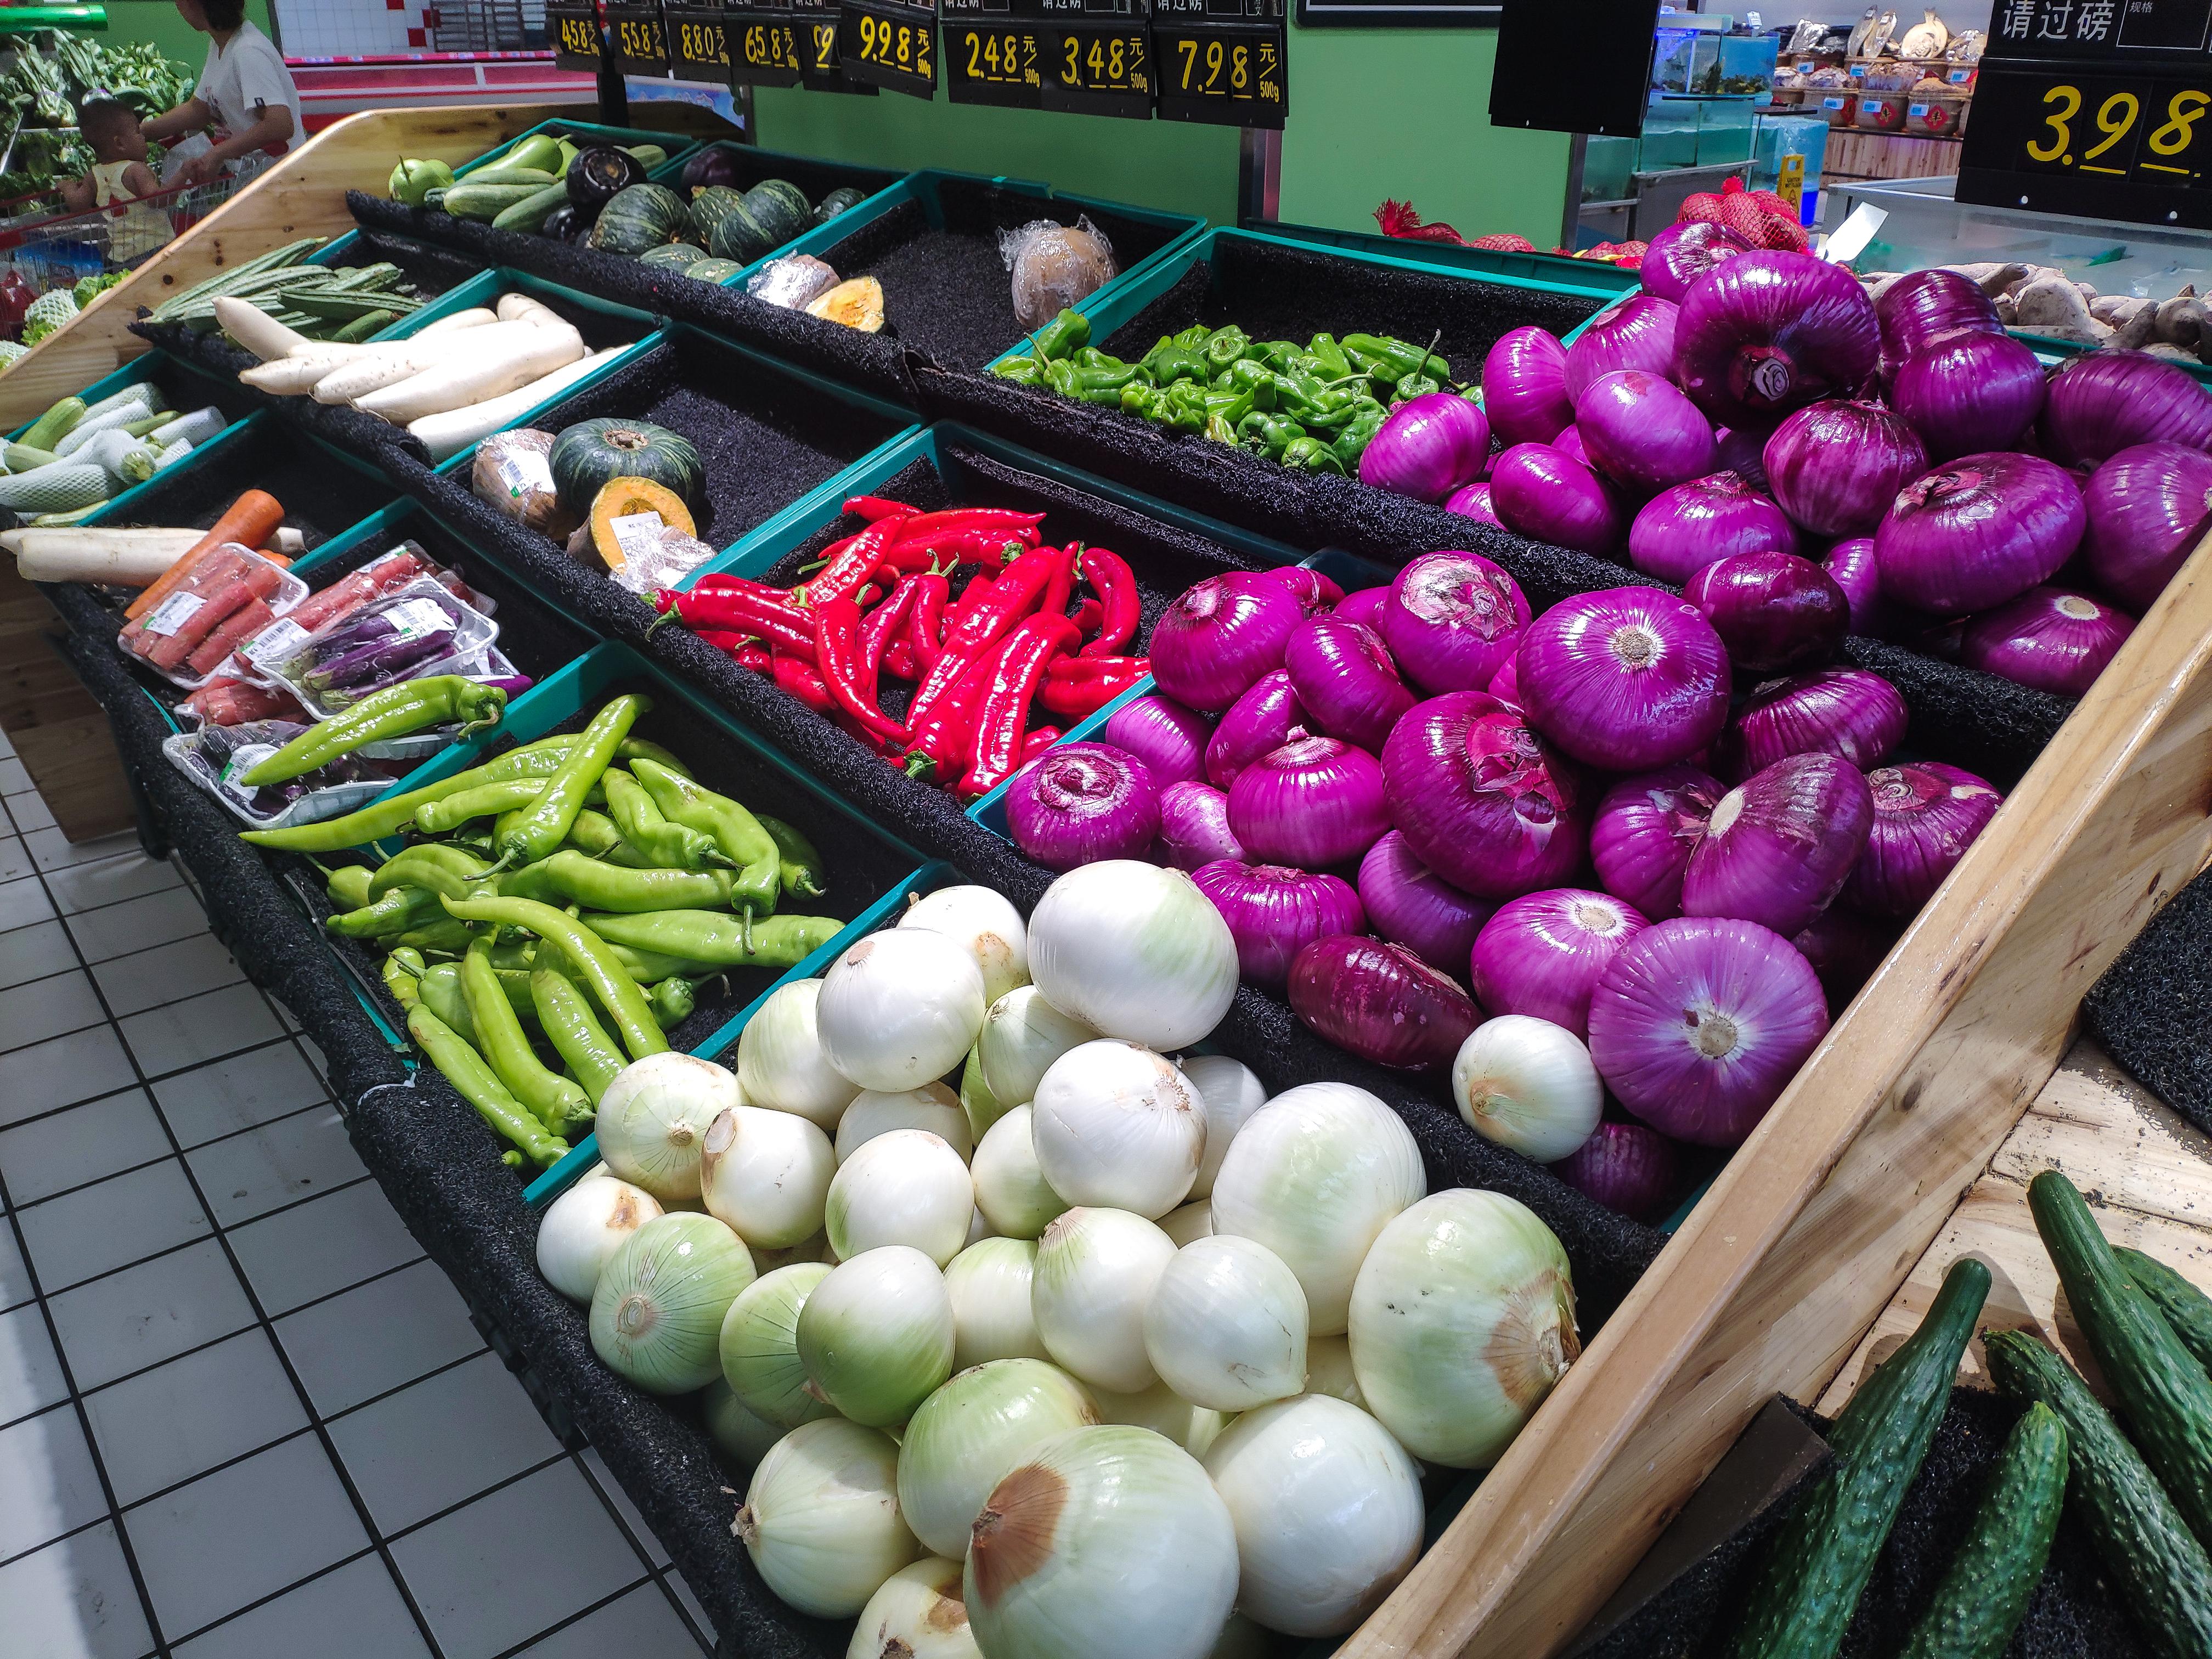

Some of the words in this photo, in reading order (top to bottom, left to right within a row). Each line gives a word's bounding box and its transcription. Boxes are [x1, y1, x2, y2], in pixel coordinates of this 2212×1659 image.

[681, 24, 714, 60] 8.80
[860, 15, 911, 63] 9.98
[2002, 0, 2115, 41] 请过磅
[745, 26, 781, 64] 6.58
[966, 32, 1017, 78] 2.48
[1061, 37, 1124, 86] 3.48
[1178, 41, 1248, 92] 7.98
[1131, 72, 1148, 93] 500g
[1260, 81, 1279, 103] 500g
[2027, 86, 2211, 165] 3.98
